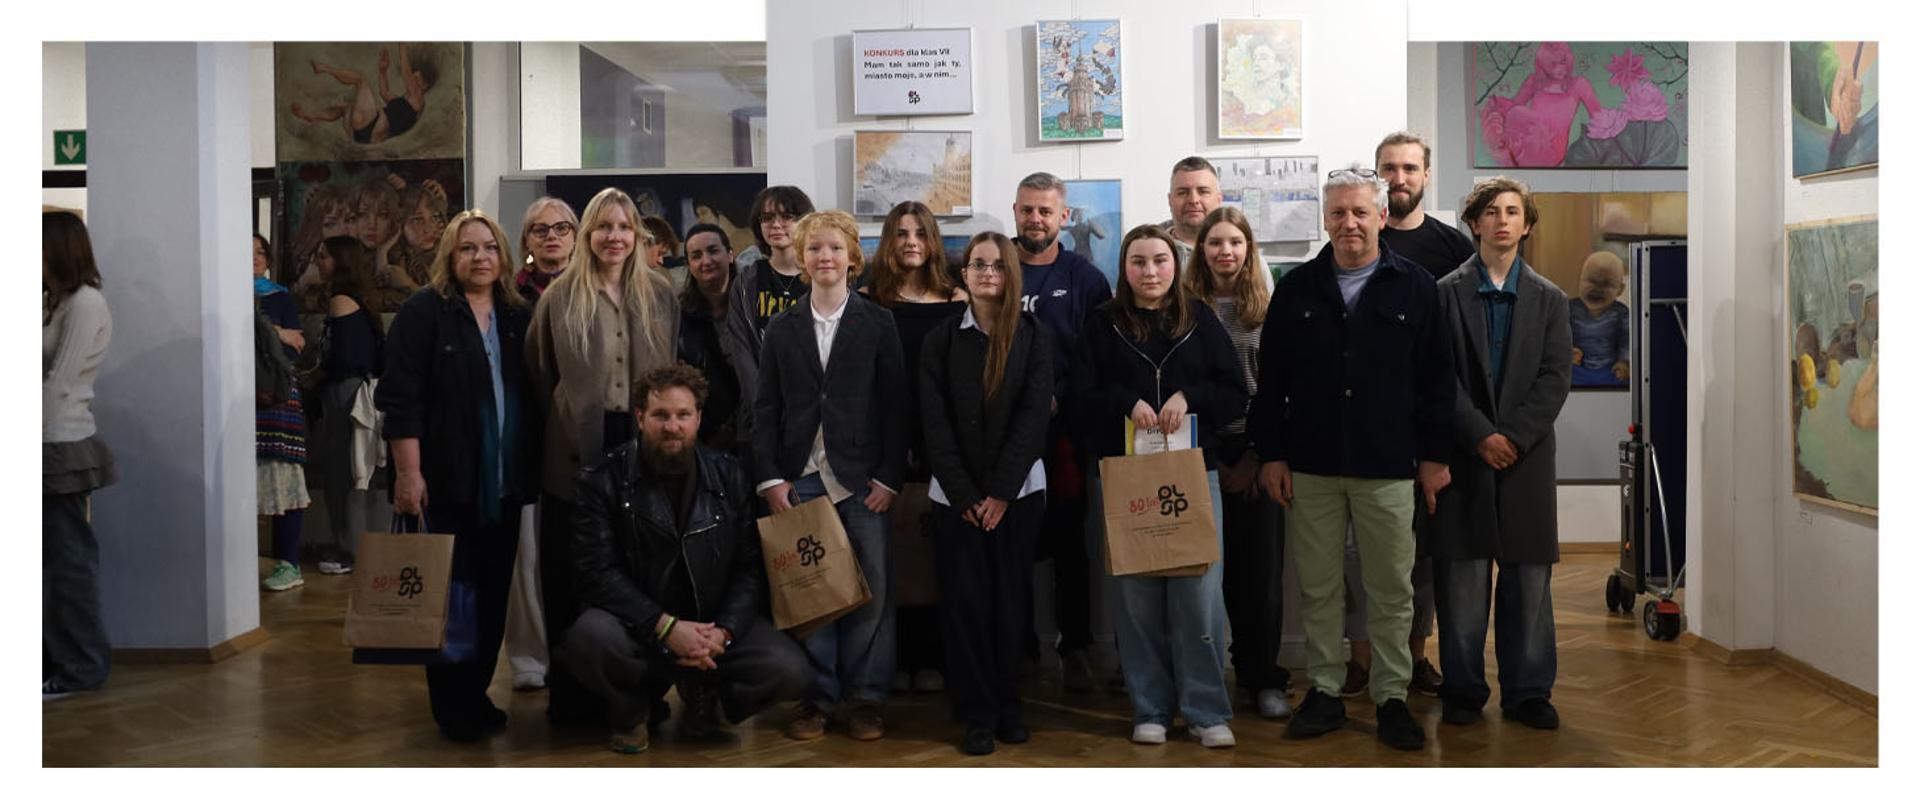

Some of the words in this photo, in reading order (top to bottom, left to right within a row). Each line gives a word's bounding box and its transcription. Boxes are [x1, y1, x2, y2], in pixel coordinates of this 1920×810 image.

[864, 49, 904, 57] KONKURS
[906, 48, 919, 56] dla
[920, 48, 938, 56] klas
[889, 60, 902, 68] tak
[934, 60, 947, 69] jak
